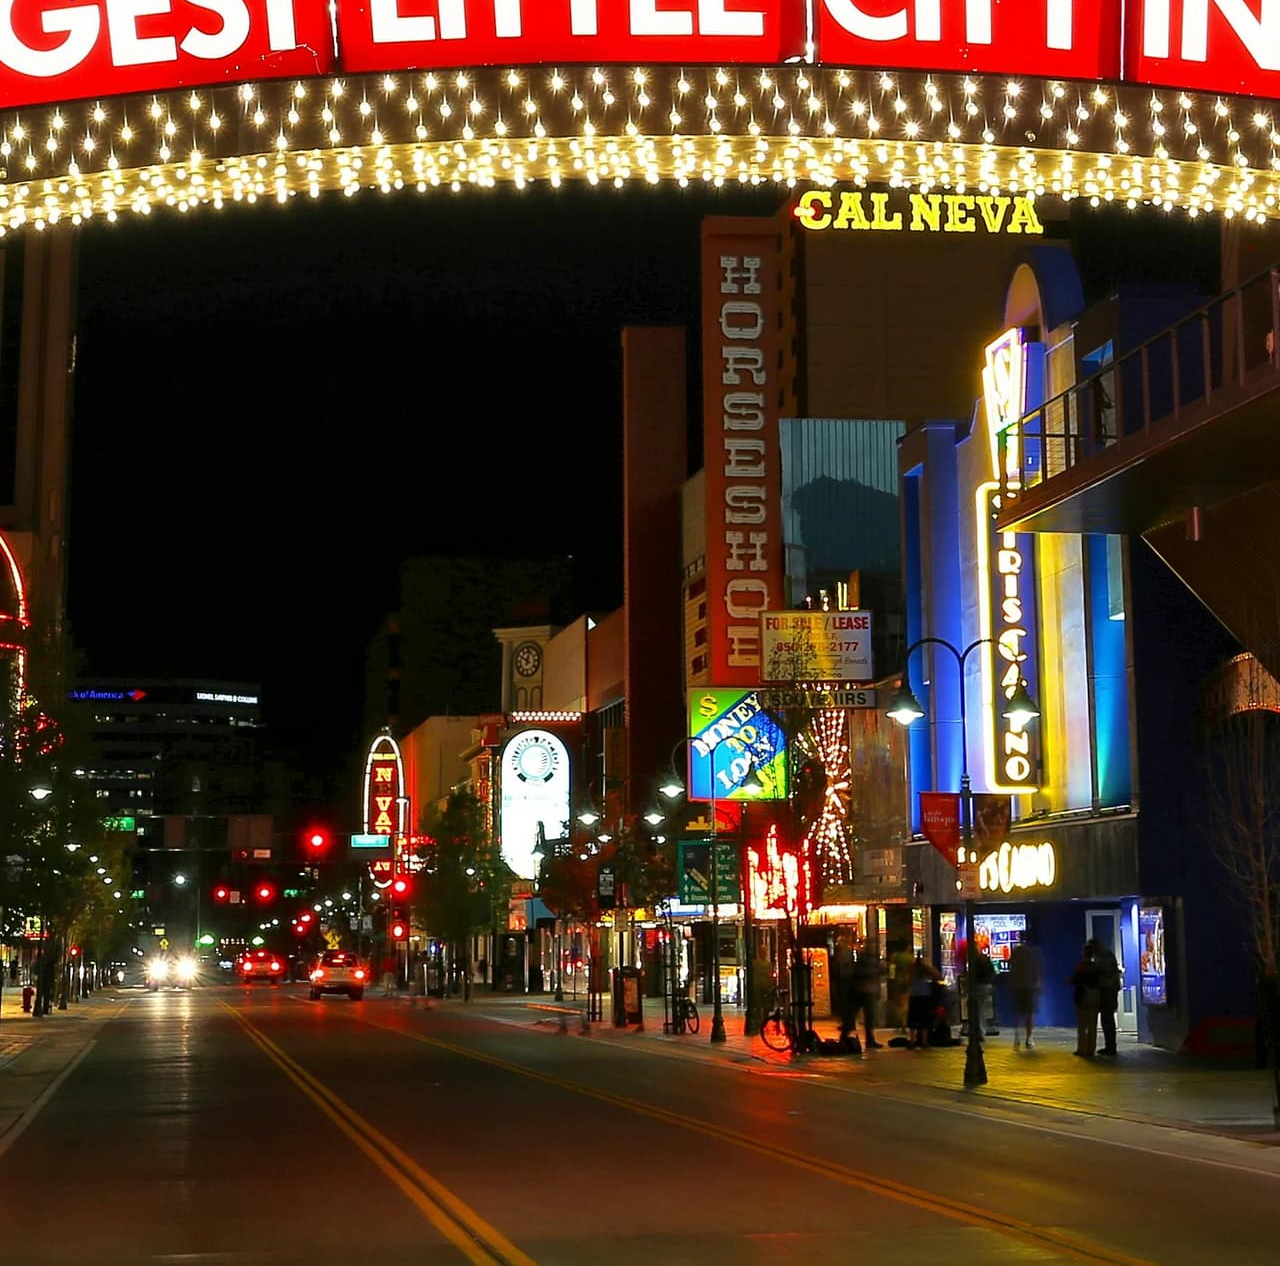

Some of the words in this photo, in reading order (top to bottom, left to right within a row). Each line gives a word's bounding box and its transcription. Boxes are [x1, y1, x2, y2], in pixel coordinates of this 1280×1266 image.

[798, 190, 903, 230] CAL
[909, 193, 1045, 234] NEVA
[719, 256, 770, 667] HORSESHOE
[766, 617, 789, 631] FOR
[792, 617, 820, 631] SALE
[832, 617, 869, 631] LEASE
[691, 692, 762, 758] MONEY
[726, 725, 758, 752] TO
[716, 736, 775, 790] LOAN
